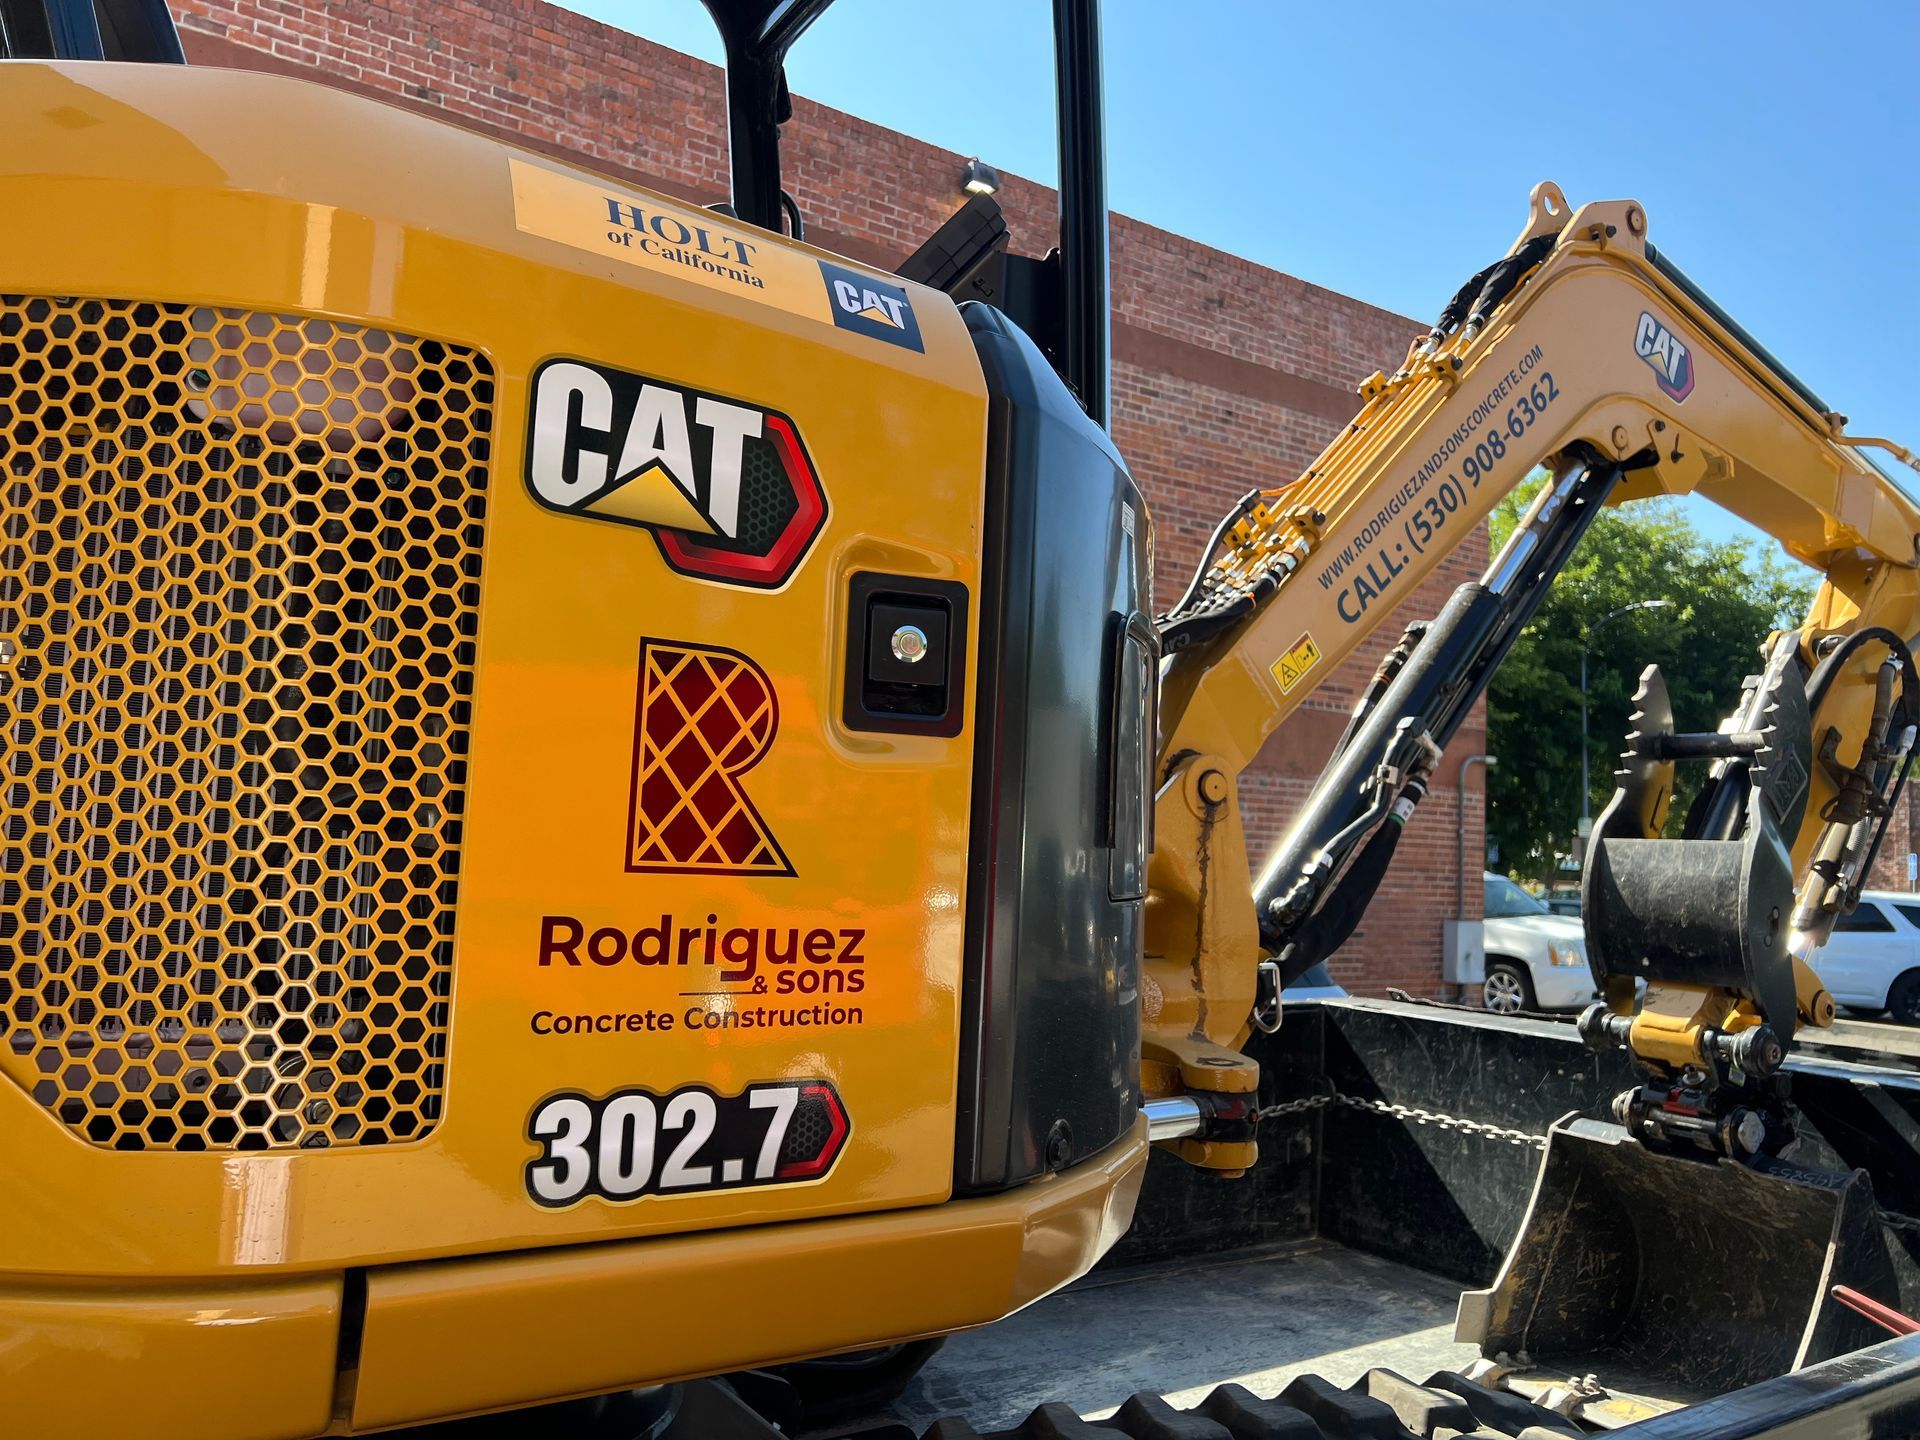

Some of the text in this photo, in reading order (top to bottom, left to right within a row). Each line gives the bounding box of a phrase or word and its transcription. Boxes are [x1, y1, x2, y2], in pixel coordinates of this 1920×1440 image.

[603, 197, 757, 267] HOLT
[607, 231, 765, 289] of California
[833, 279, 906, 330] CAT
[1635, 312, 1686, 384] CAT
[531, 362, 763, 539] CAT
[1317, 344, 1544, 590] WWW.RODRIGUEZANDSONSCONCRETE.COM
[1337, 371, 1560, 624] CALL: (530) 908-6362
[538, 913, 866, 982] Rodriguez
[751, 967, 865, 995] & sons
[530, 1001, 863, 1035] Concrete Construction
[531, 1087, 799, 1200] 302.7
